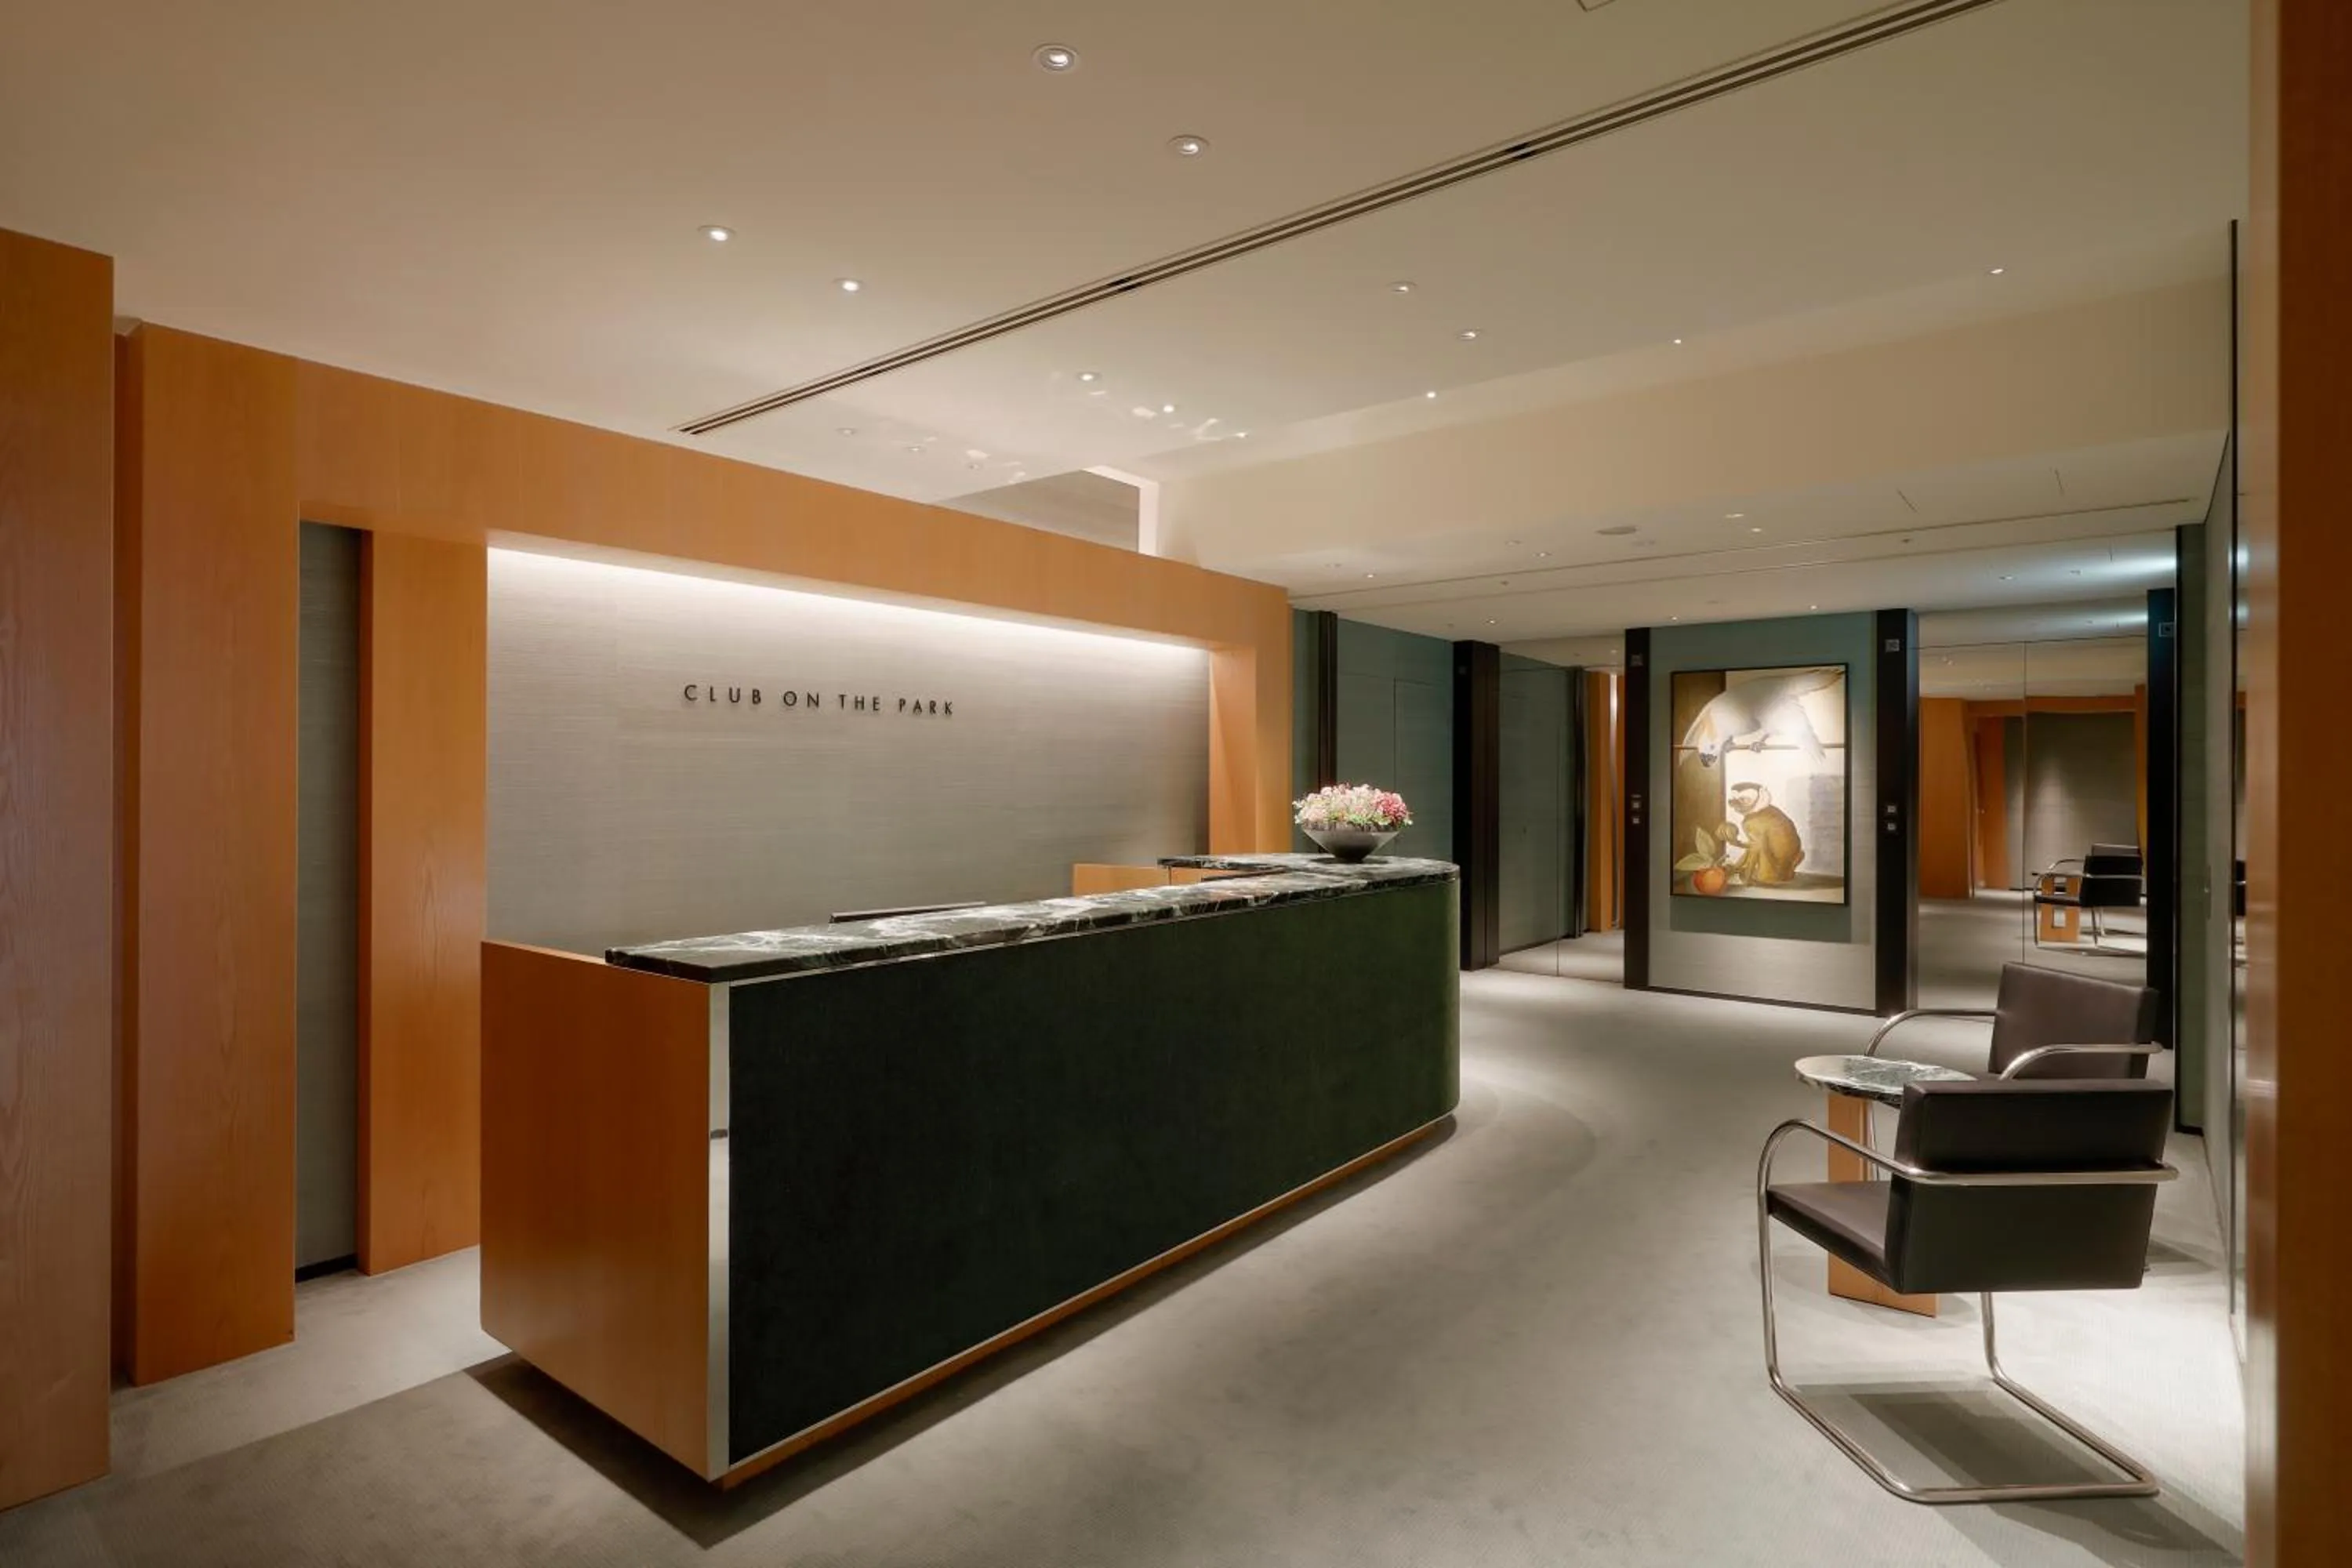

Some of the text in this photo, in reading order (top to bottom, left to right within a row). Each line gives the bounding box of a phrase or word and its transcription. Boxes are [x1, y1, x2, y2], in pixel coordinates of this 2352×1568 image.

[684, 684, 953, 715] CLUB ON THE PARK
